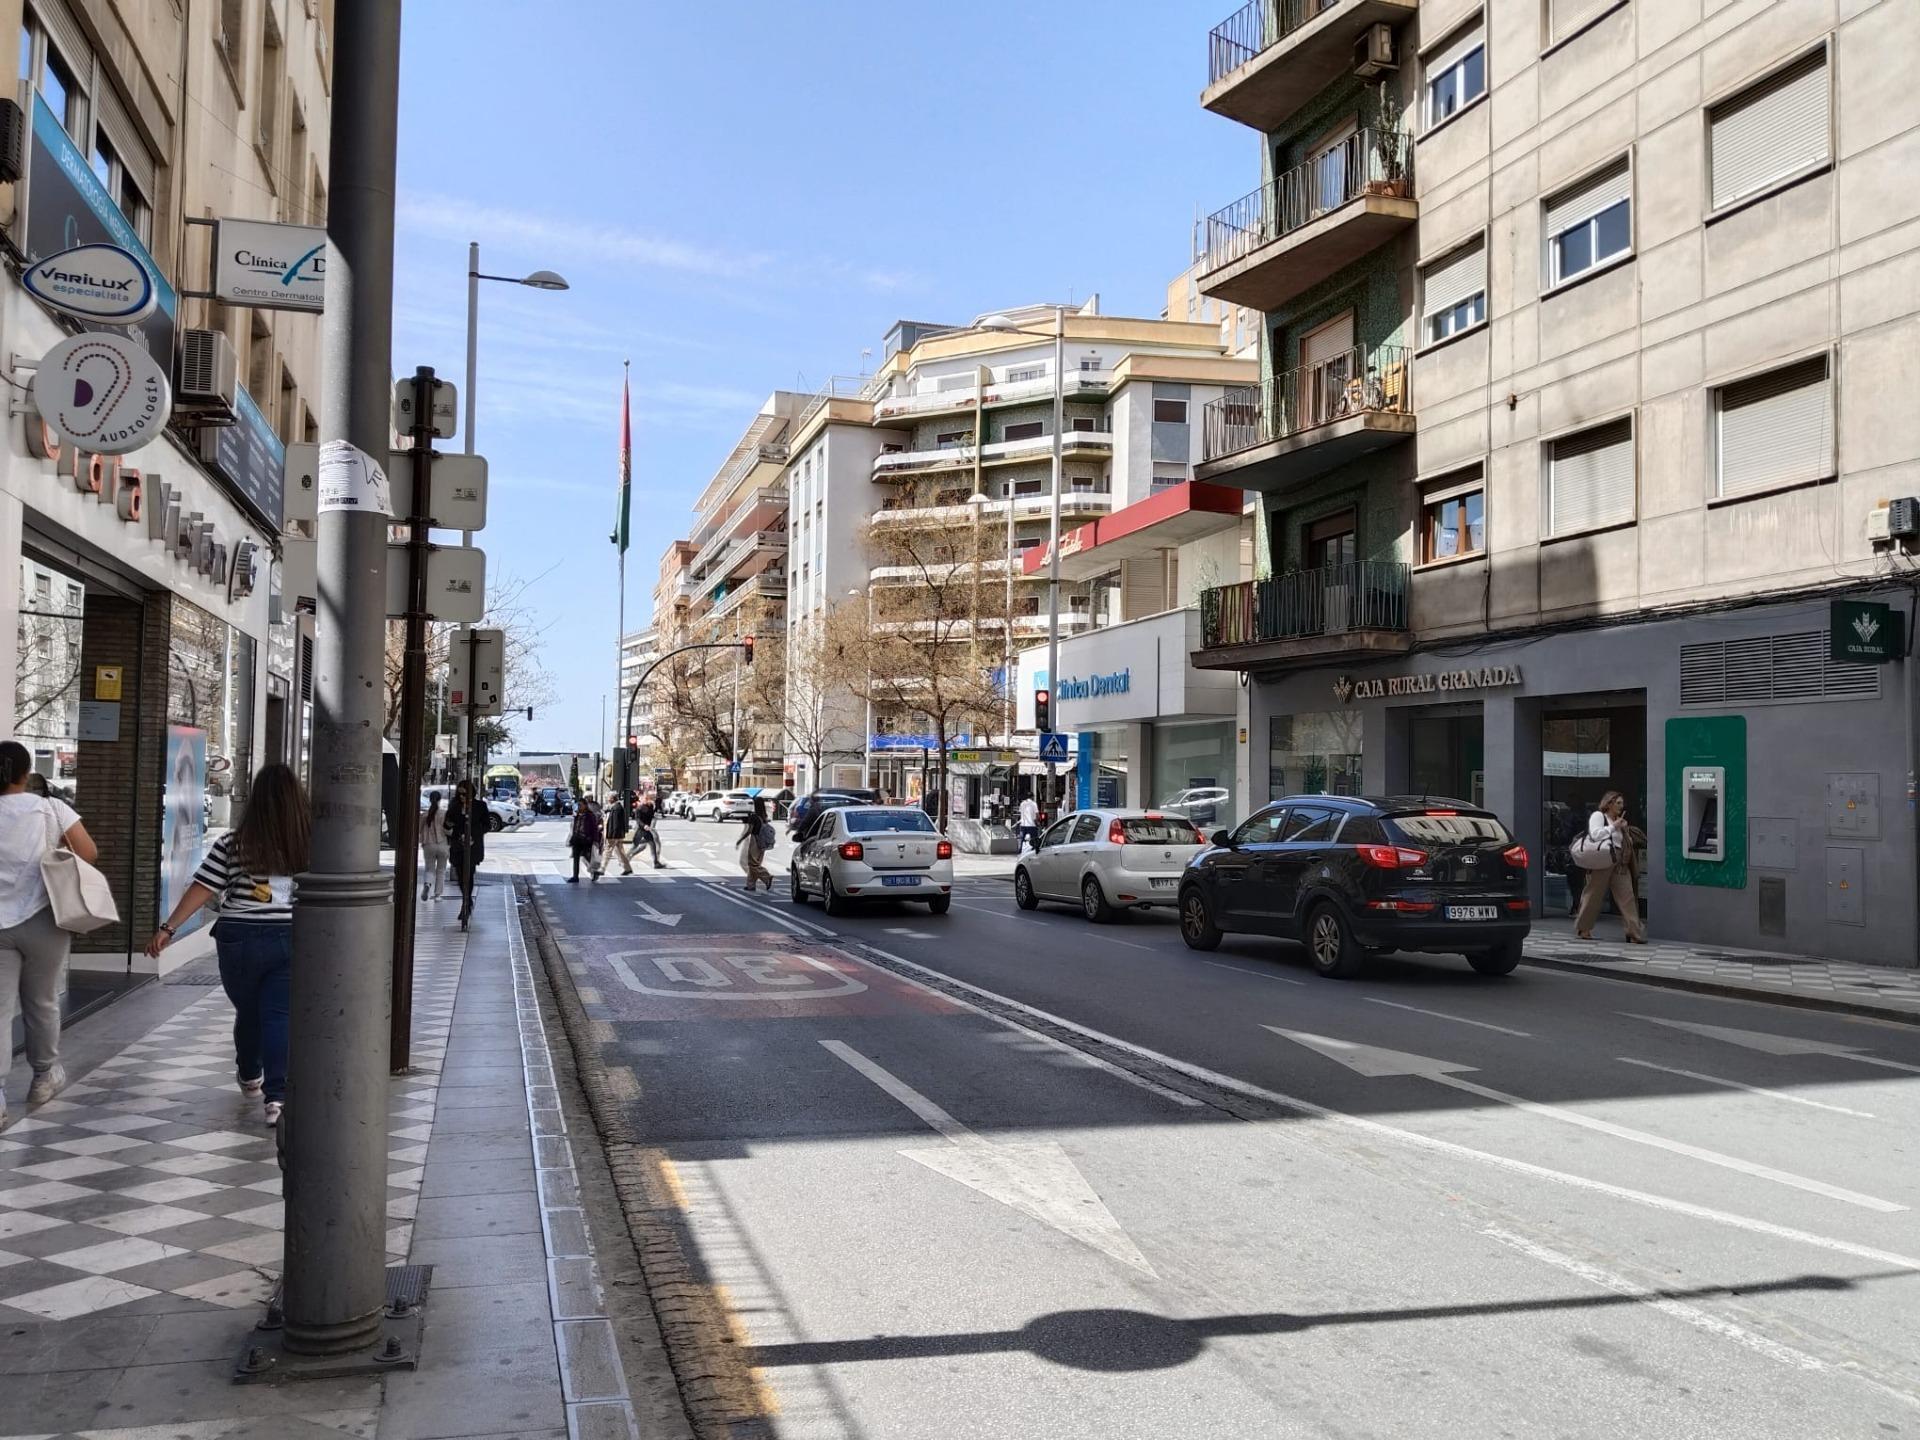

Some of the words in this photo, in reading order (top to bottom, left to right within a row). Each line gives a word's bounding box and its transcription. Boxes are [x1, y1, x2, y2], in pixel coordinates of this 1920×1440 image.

[234, 250, 287, 269] Clínica
[52, 284, 129, 302] especialista
[232, 286, 268, 297] Centro
[99, 376, 158, 443] AUDIOLOGÍA
[1090, 667, 1130, 697] Dental
[1354, 679, 1385, 699] CAJA
[1388, 673, 1435, 696] RURAL
[1438, 664, 1522, 691] GRANADA
[1450, 907, 1475, 918] 9976
